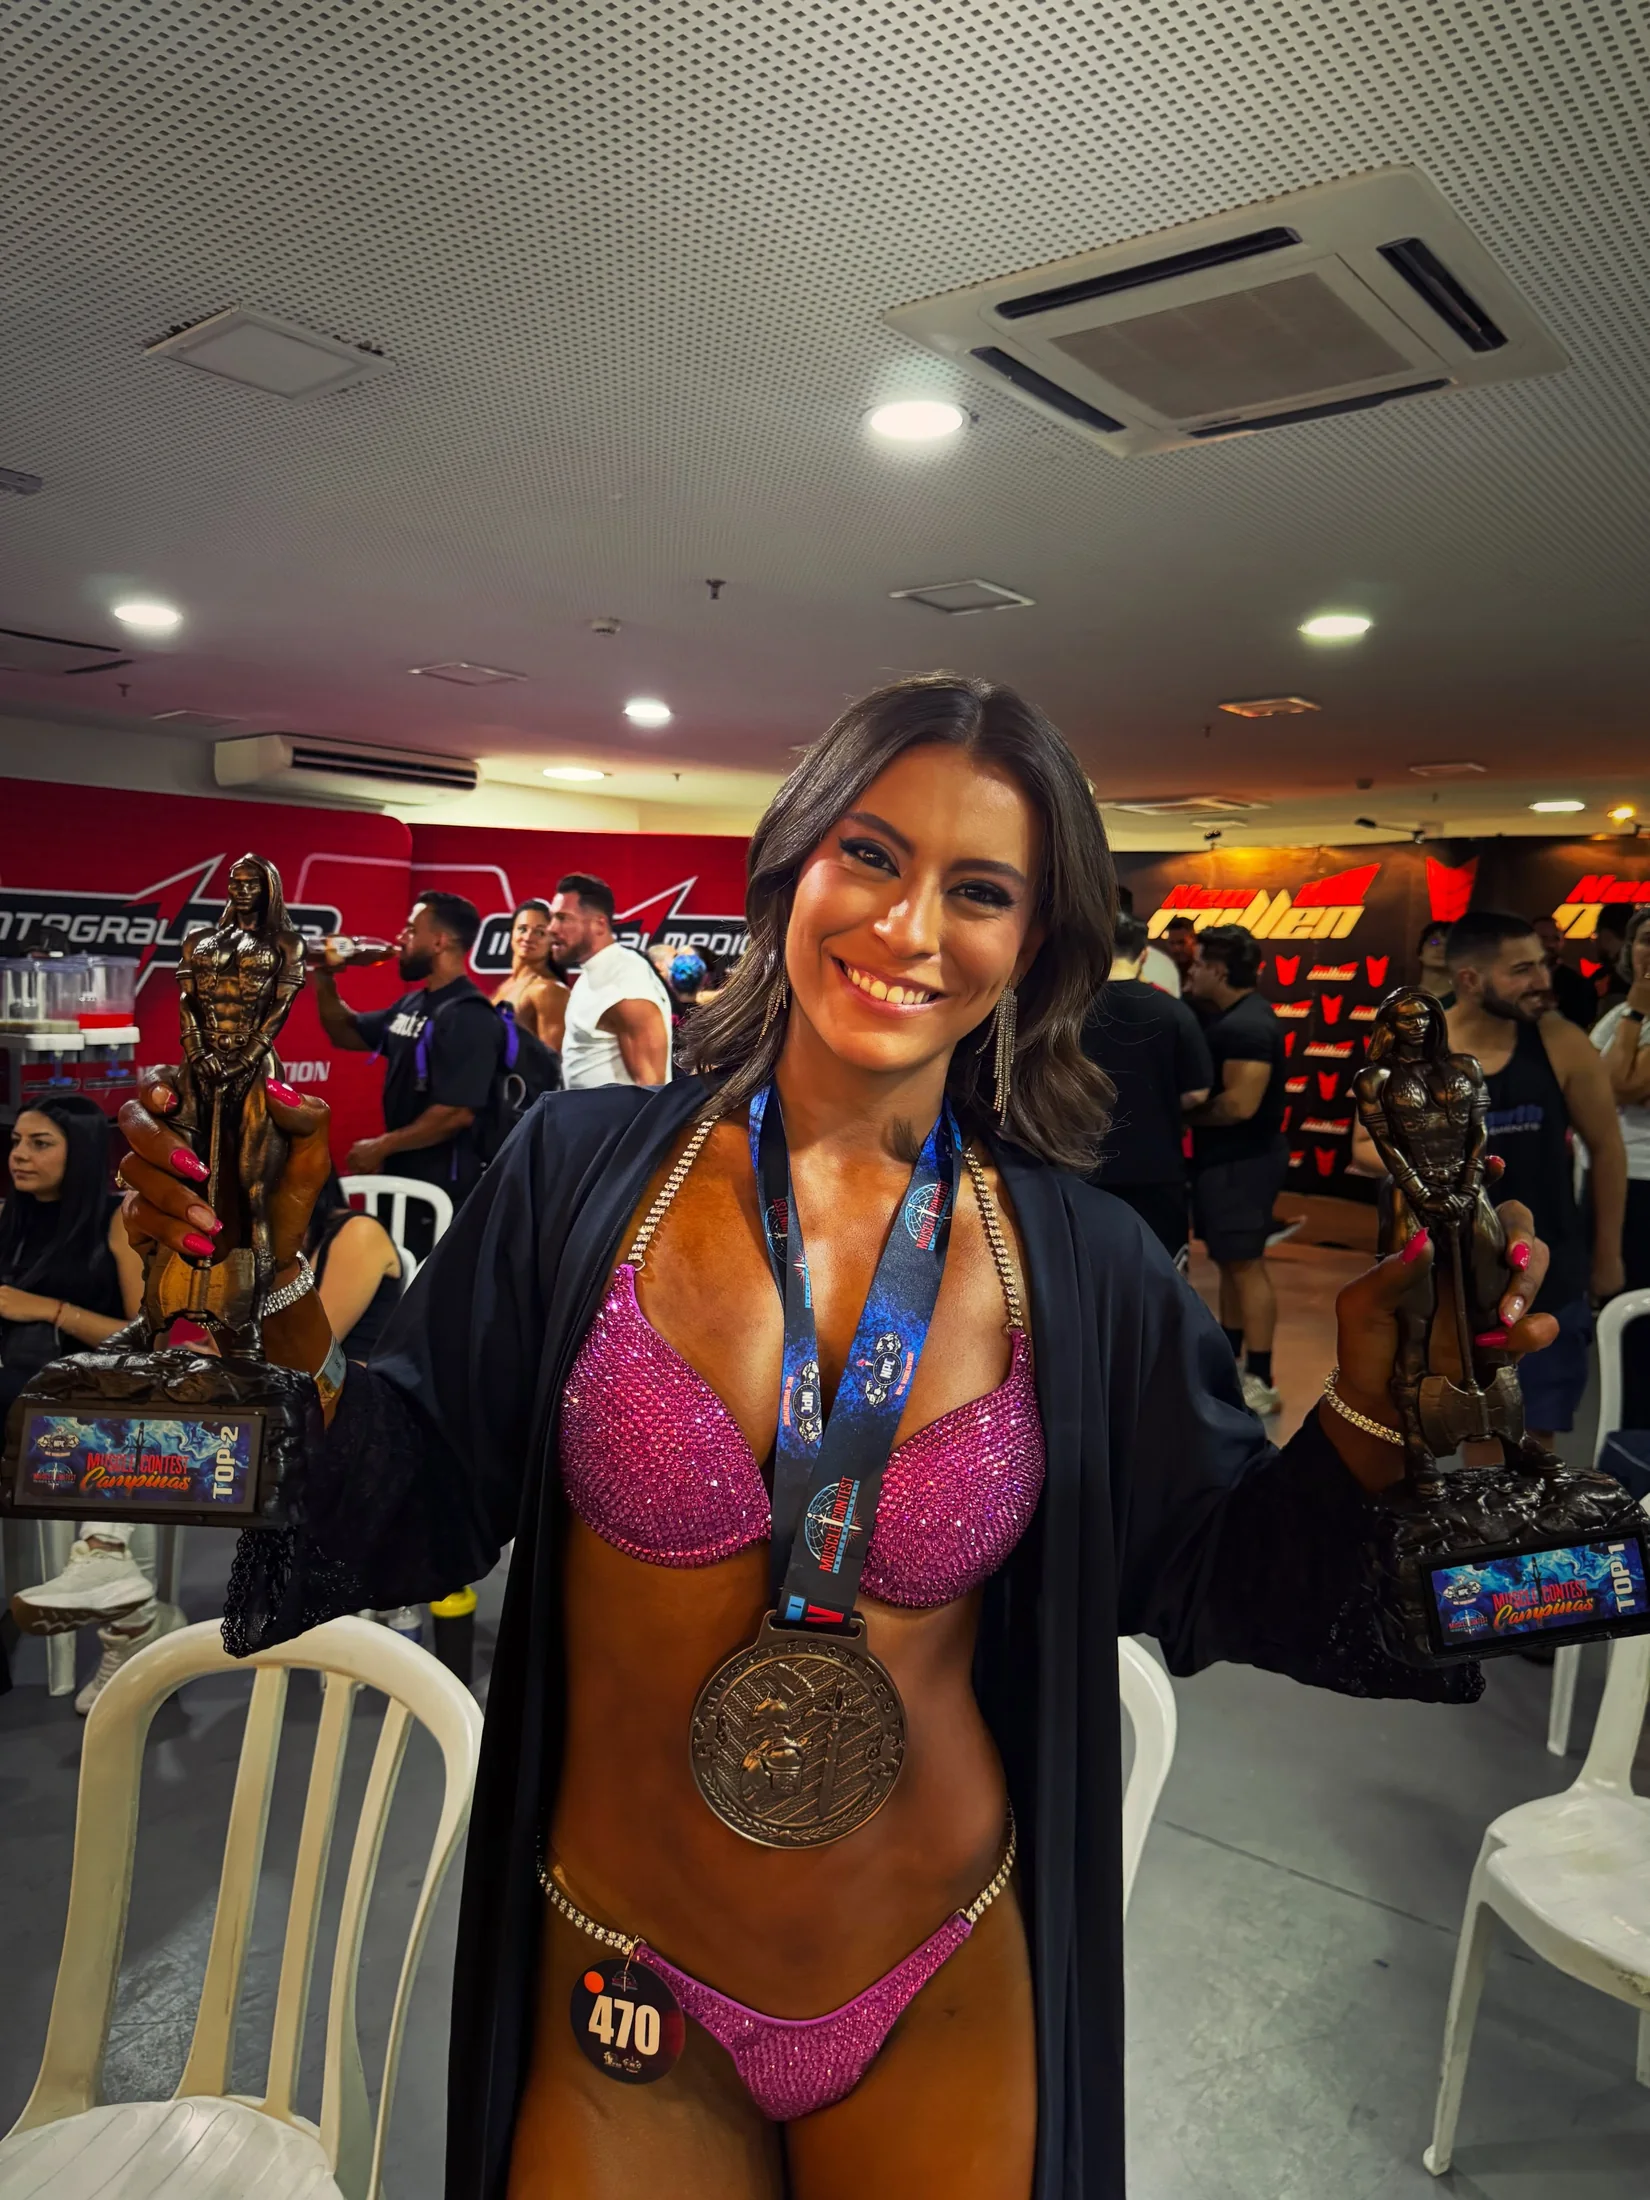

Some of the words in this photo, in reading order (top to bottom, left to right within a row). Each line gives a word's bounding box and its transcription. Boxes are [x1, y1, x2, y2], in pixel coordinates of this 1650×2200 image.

[880, 1357, 896, 1379] NPC
[800, 1391, 814, 1414] NPC
[220, 1426, 239, 1448] 2
[86, 1452, 135, 1473] MUSCLE
[140, 1455, 190, 1475] CONTEST
[212, 1447, 238, 1500] TOP
[80, 1465, 192, 1494] Campinas
[818, 1524, 842, 1573] MUSCLE
[832, 1475, 854, 1524] CONTEST
[1607, 1543, 1626, 1555] 1
[1492, 1587, 1540, 1612] MUSCLE
[1541, 1579, 1588, 1603] CONTEST
[1610, 1560, 1636, 1614] TOP
[1492, 1597, 1594, 1632] Campinas
[588, 1994, 660, 2056] 470
